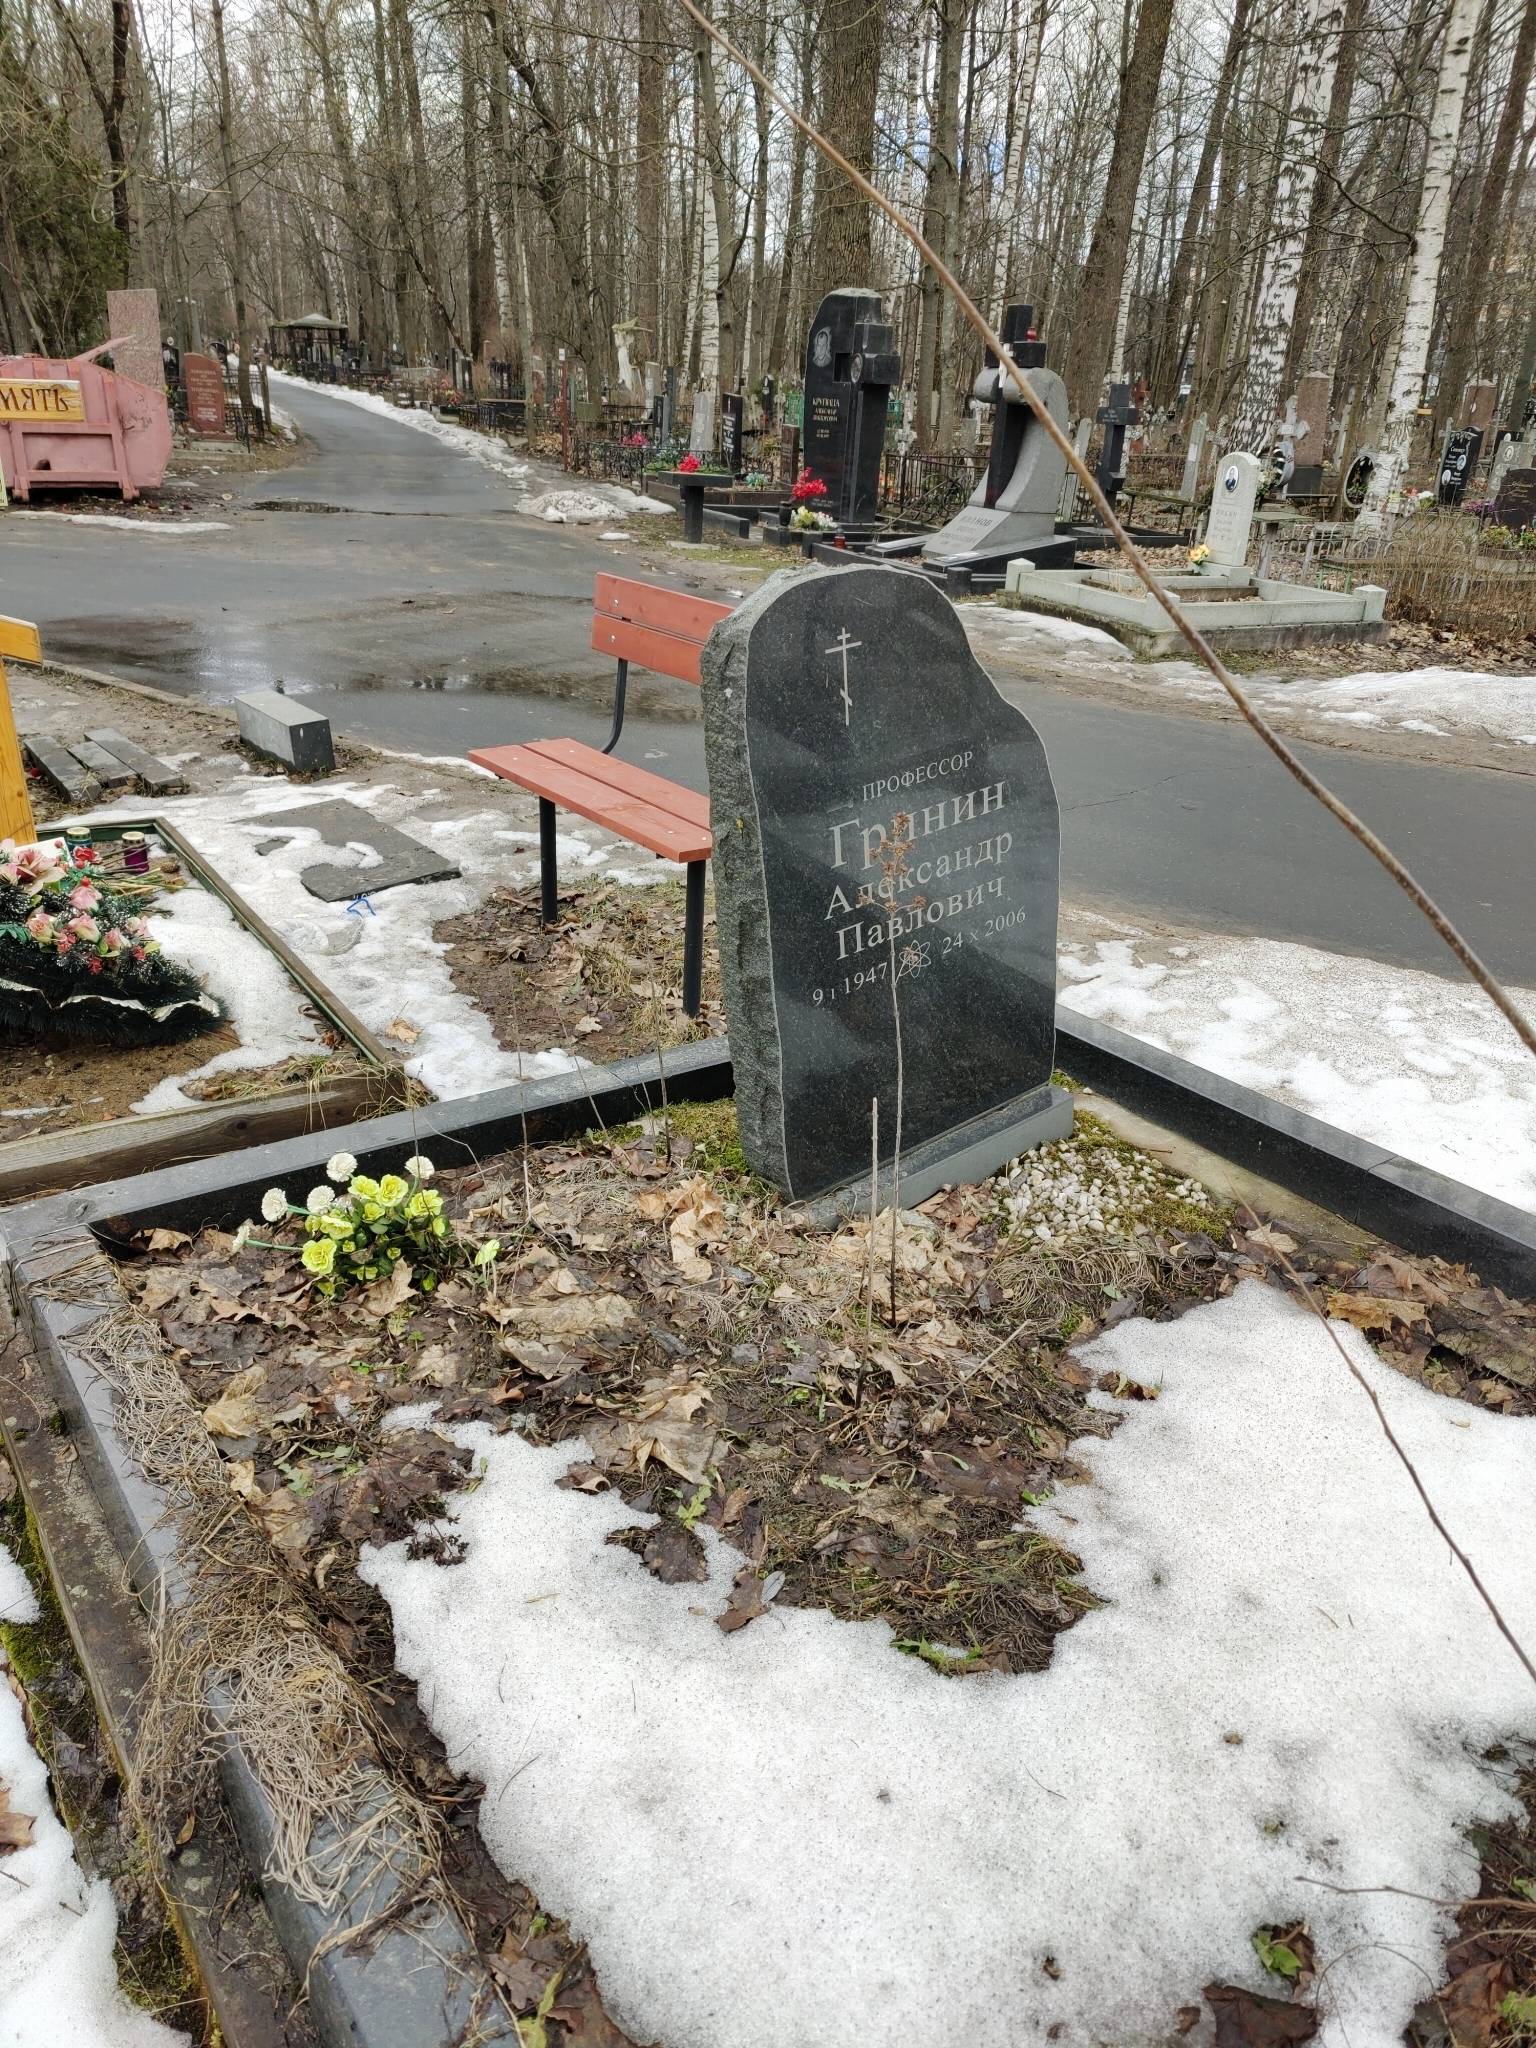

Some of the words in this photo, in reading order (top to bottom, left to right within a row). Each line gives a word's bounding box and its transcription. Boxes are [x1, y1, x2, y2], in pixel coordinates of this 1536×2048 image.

[862, 751, 974, 802] ПРОФЕССОР
[812, 988, 824, 1007] 9
[844, 961, 888, 995] 1947
[942, 932, 964, 955] 24
[984, 906, 1027, 938] 2006
[835, 876, 1006, 961] Павлович
